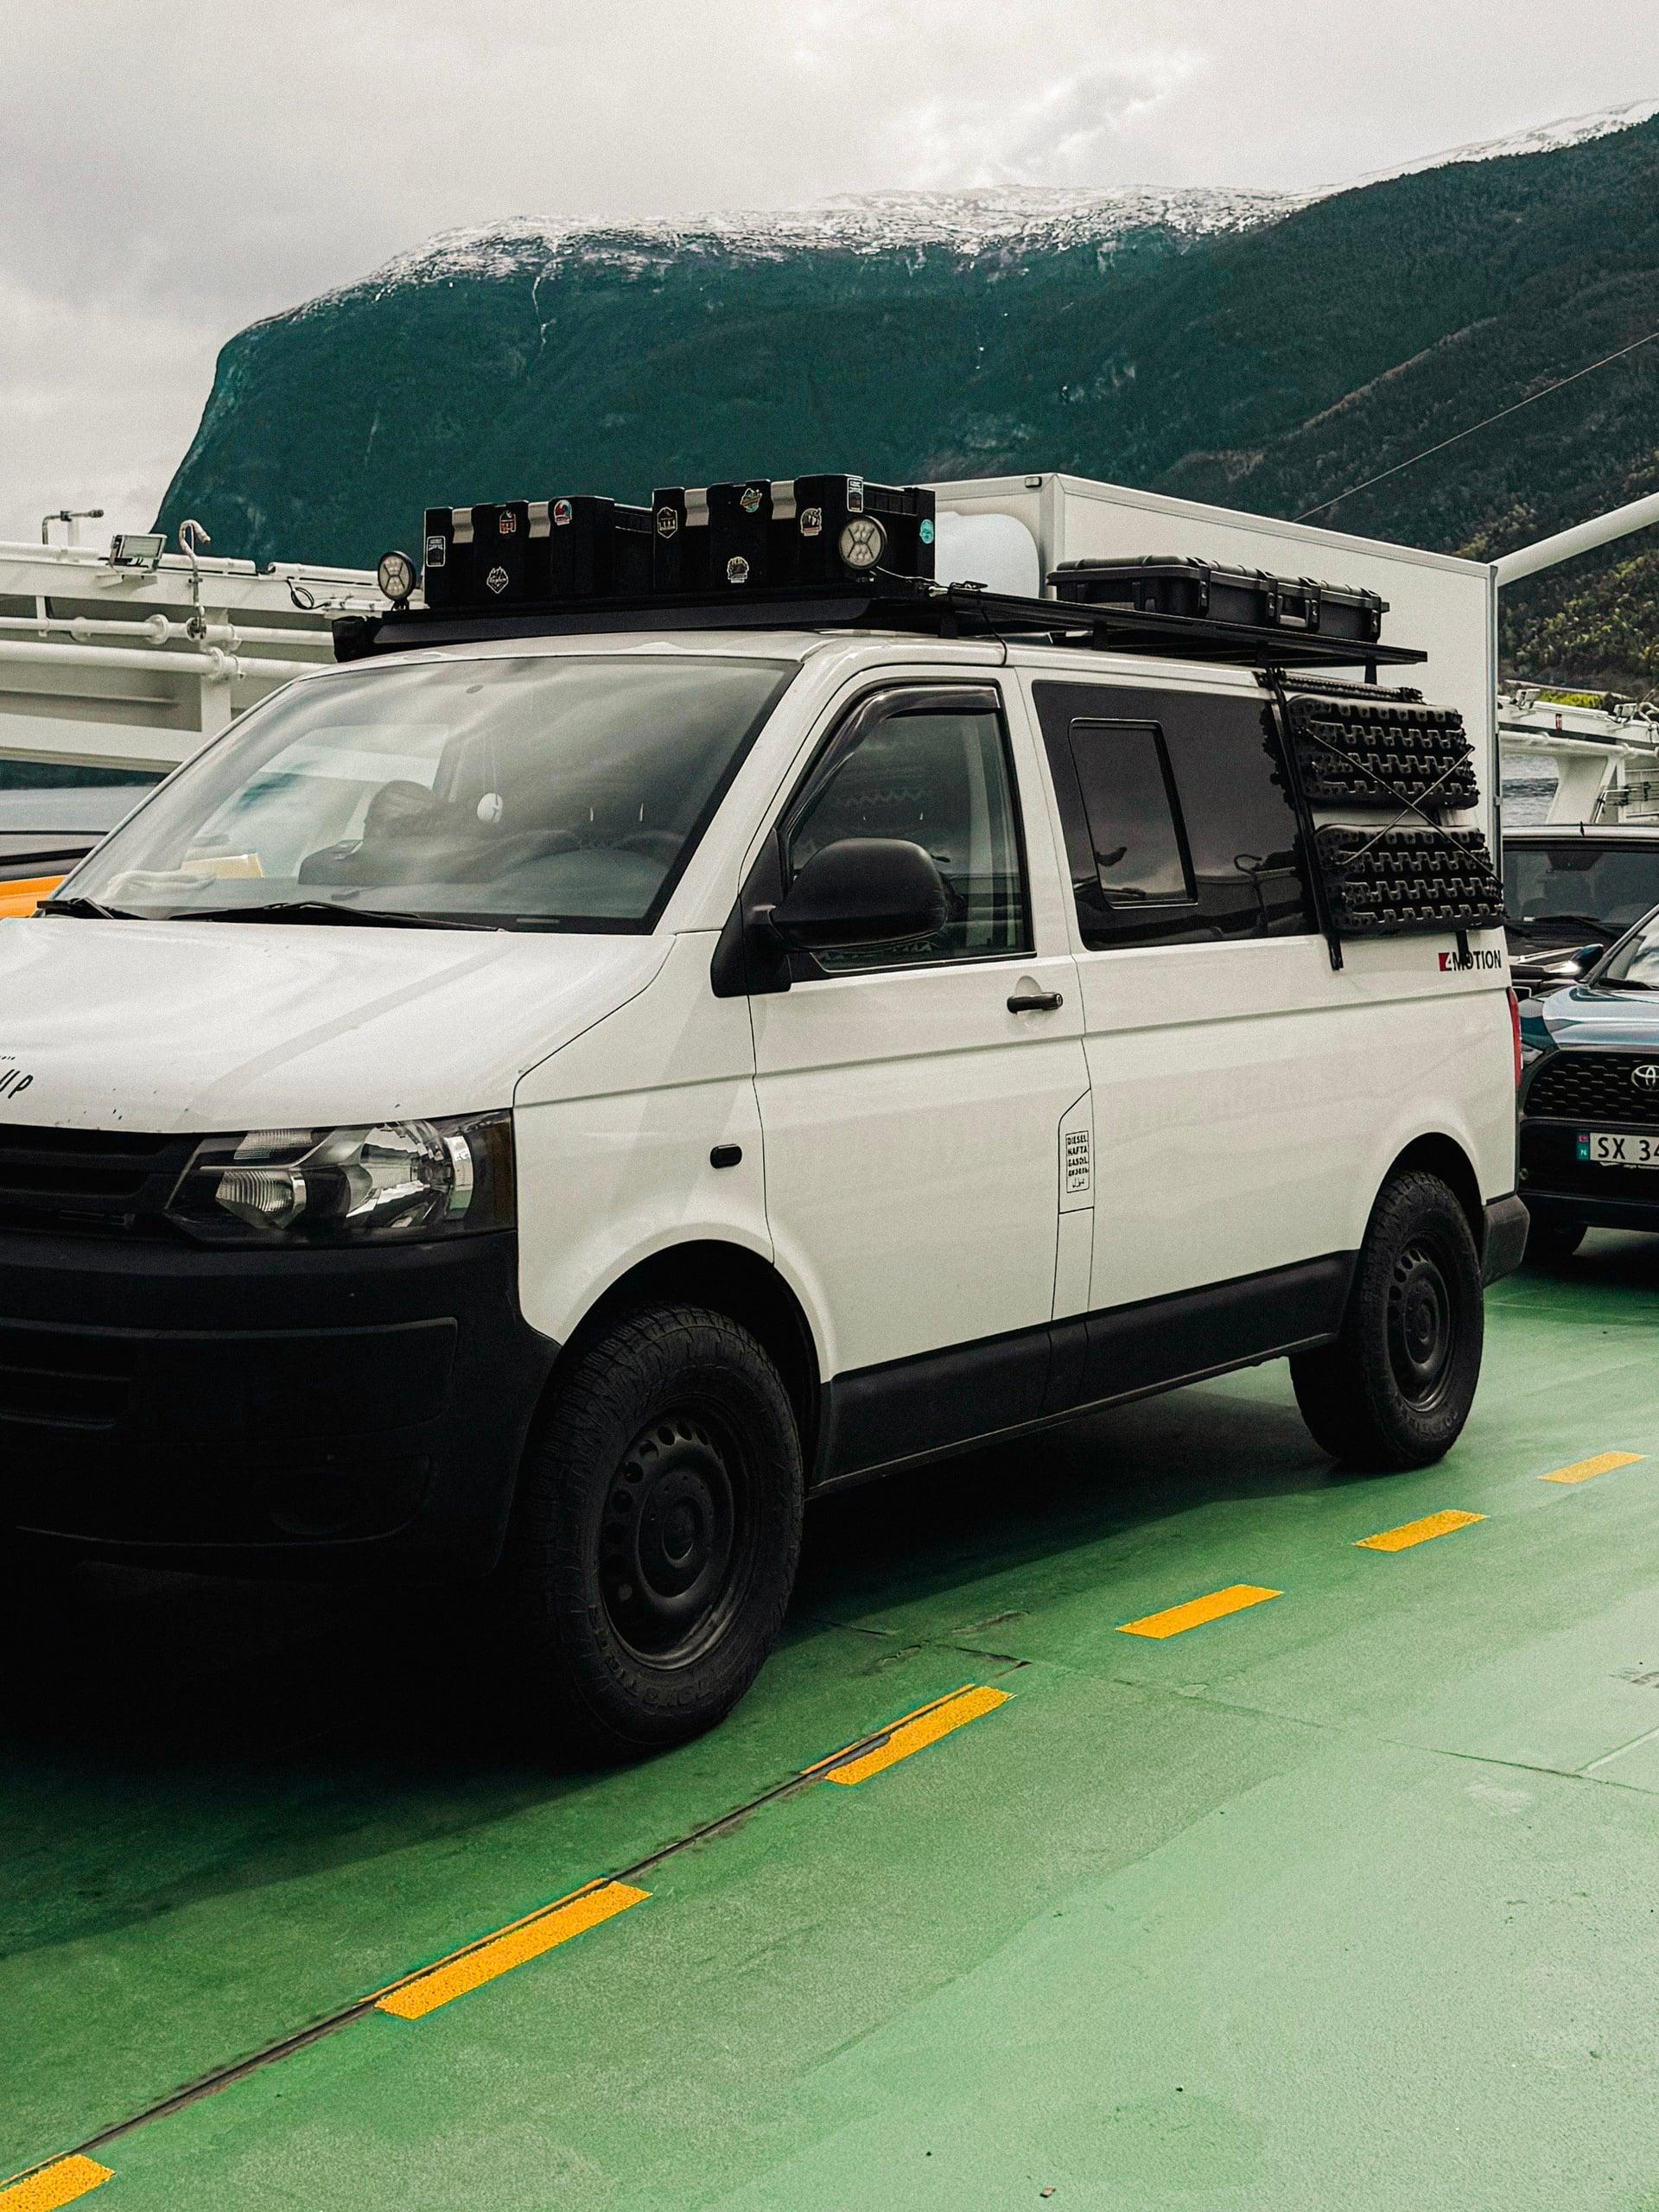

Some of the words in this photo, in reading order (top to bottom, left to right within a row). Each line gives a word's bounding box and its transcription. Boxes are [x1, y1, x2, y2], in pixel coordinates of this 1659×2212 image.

[1439, 950, 1502, 971] 4MOTION
[1067, 1135, 1088, 1145] DIESEL
[1067, 1146, 1088, 1156] NAFTA
[1598, 1137, 1625, 1160] SX
